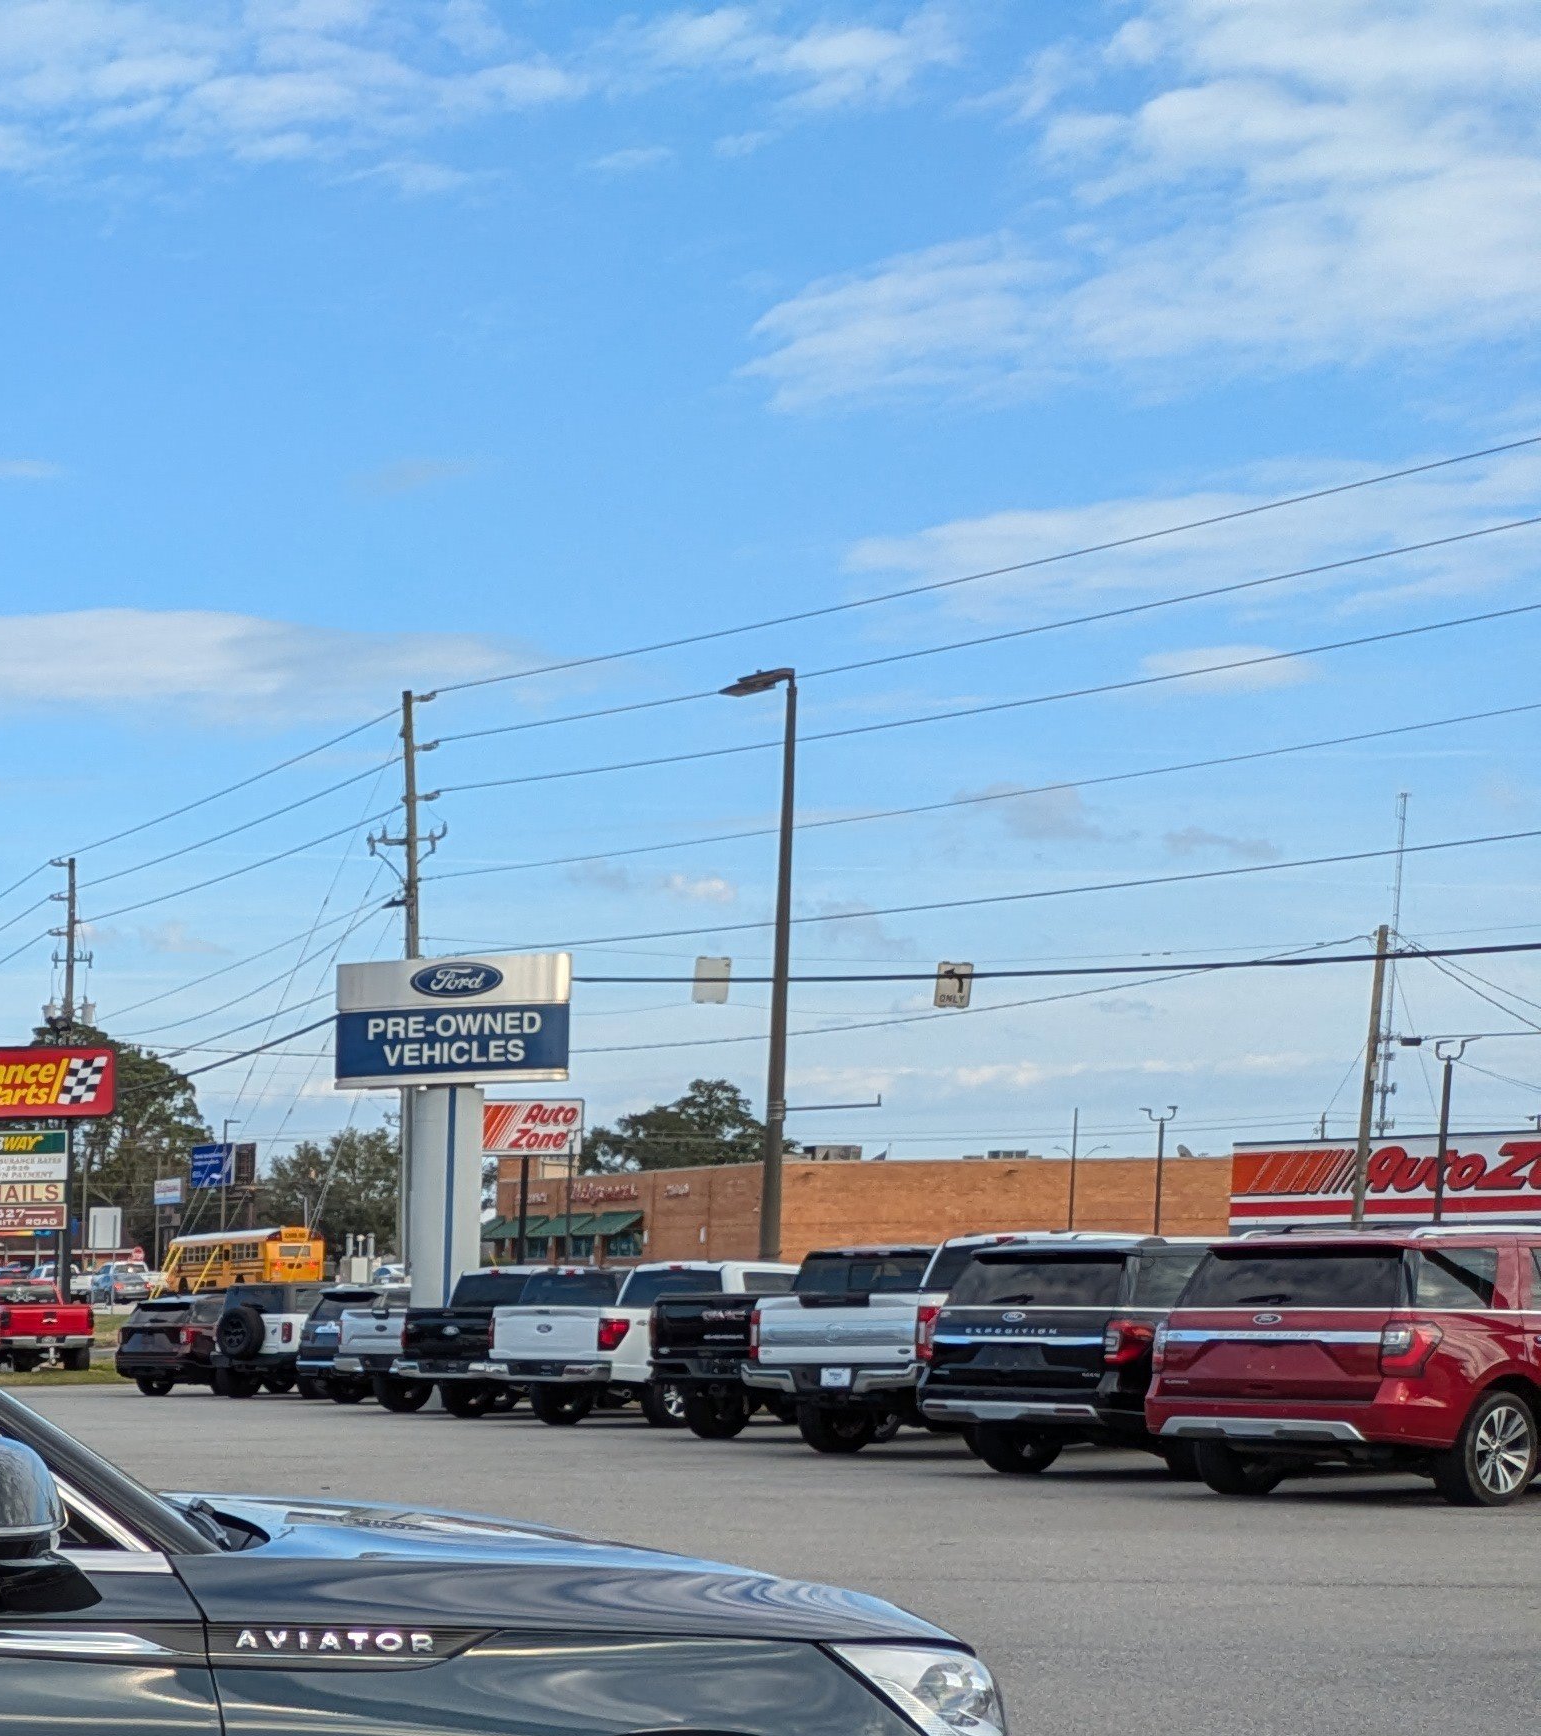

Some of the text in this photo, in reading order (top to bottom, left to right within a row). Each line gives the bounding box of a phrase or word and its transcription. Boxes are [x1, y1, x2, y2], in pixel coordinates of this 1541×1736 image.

[430, 968, 485, 991] Ford
[368, 1011, 542, 1040] PRE-OWNED
[383, 1039, 525, 1066] VEHICLES
[522, 1103, 579, 1126] Auto
[508, 1128, 568, 1150] Zone
[11, 1171, 54, 1179] PAYMENT
[25, 1218, 58, 1226] ROAD
[235, 1629, 434, 1652] AVIATOR
